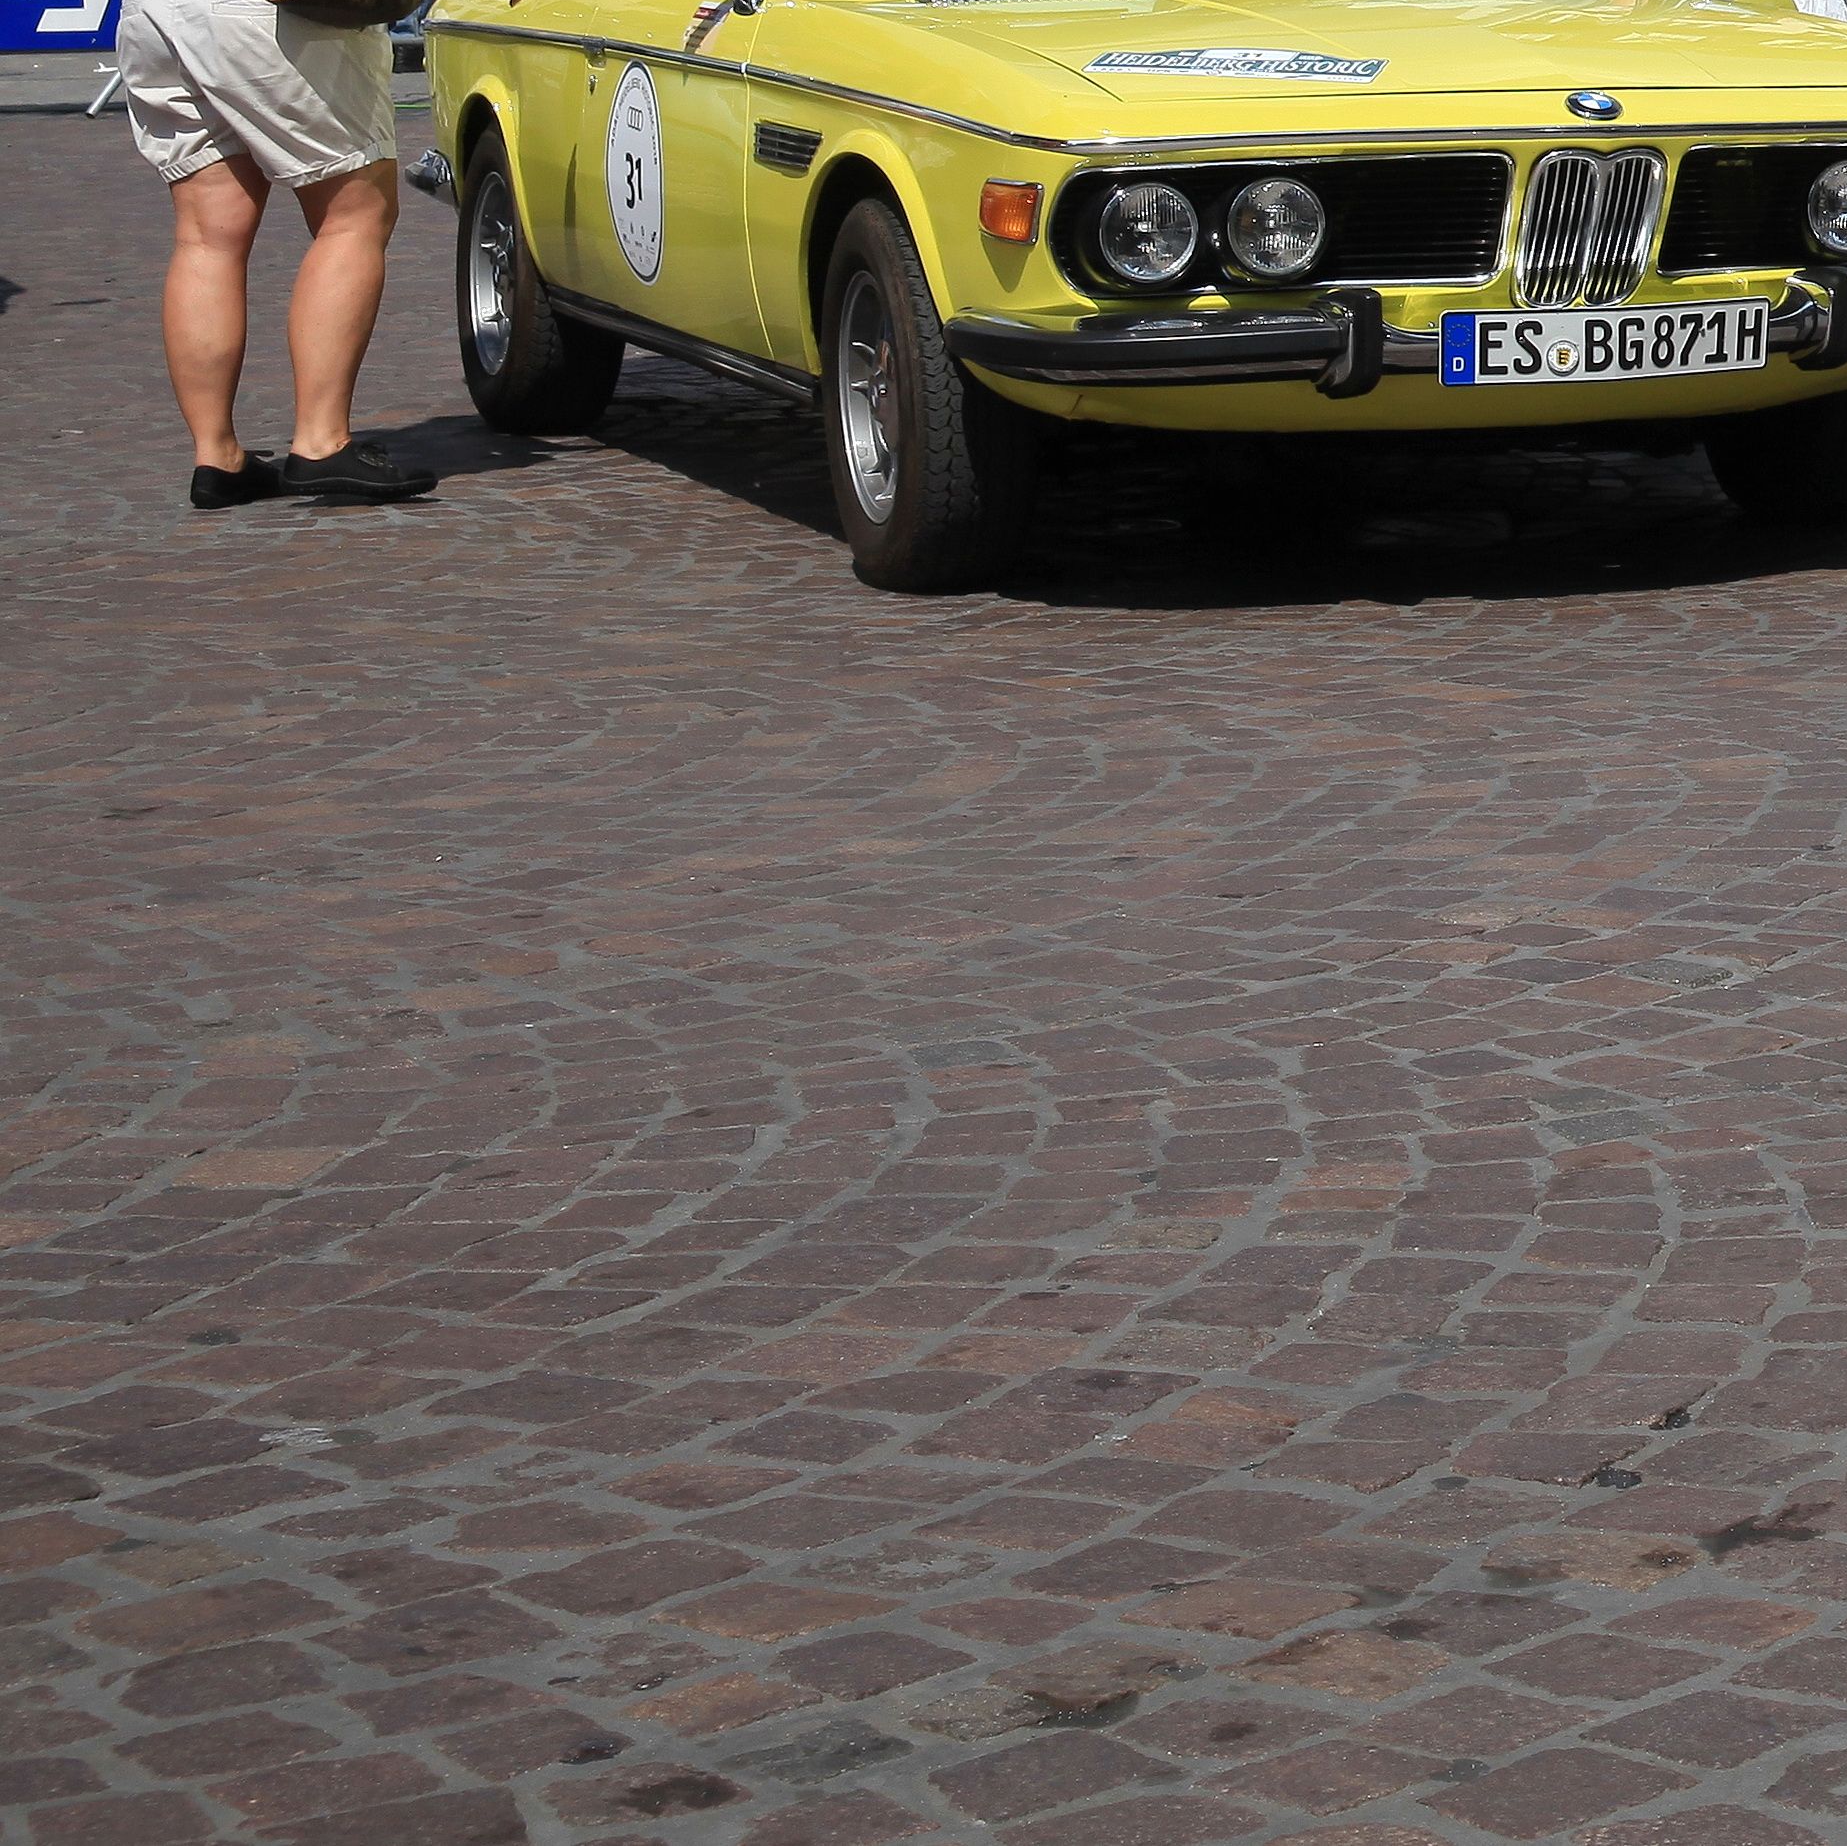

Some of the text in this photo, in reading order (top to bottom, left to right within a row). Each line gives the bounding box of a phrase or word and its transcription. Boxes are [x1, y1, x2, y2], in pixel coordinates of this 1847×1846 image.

[1257, 58, 1378, 76] HISTORIC
[625, 152, 643, 210] 31
[1452, 357, 1465, 373] D
[1478, 319, 1544, 375] ES
